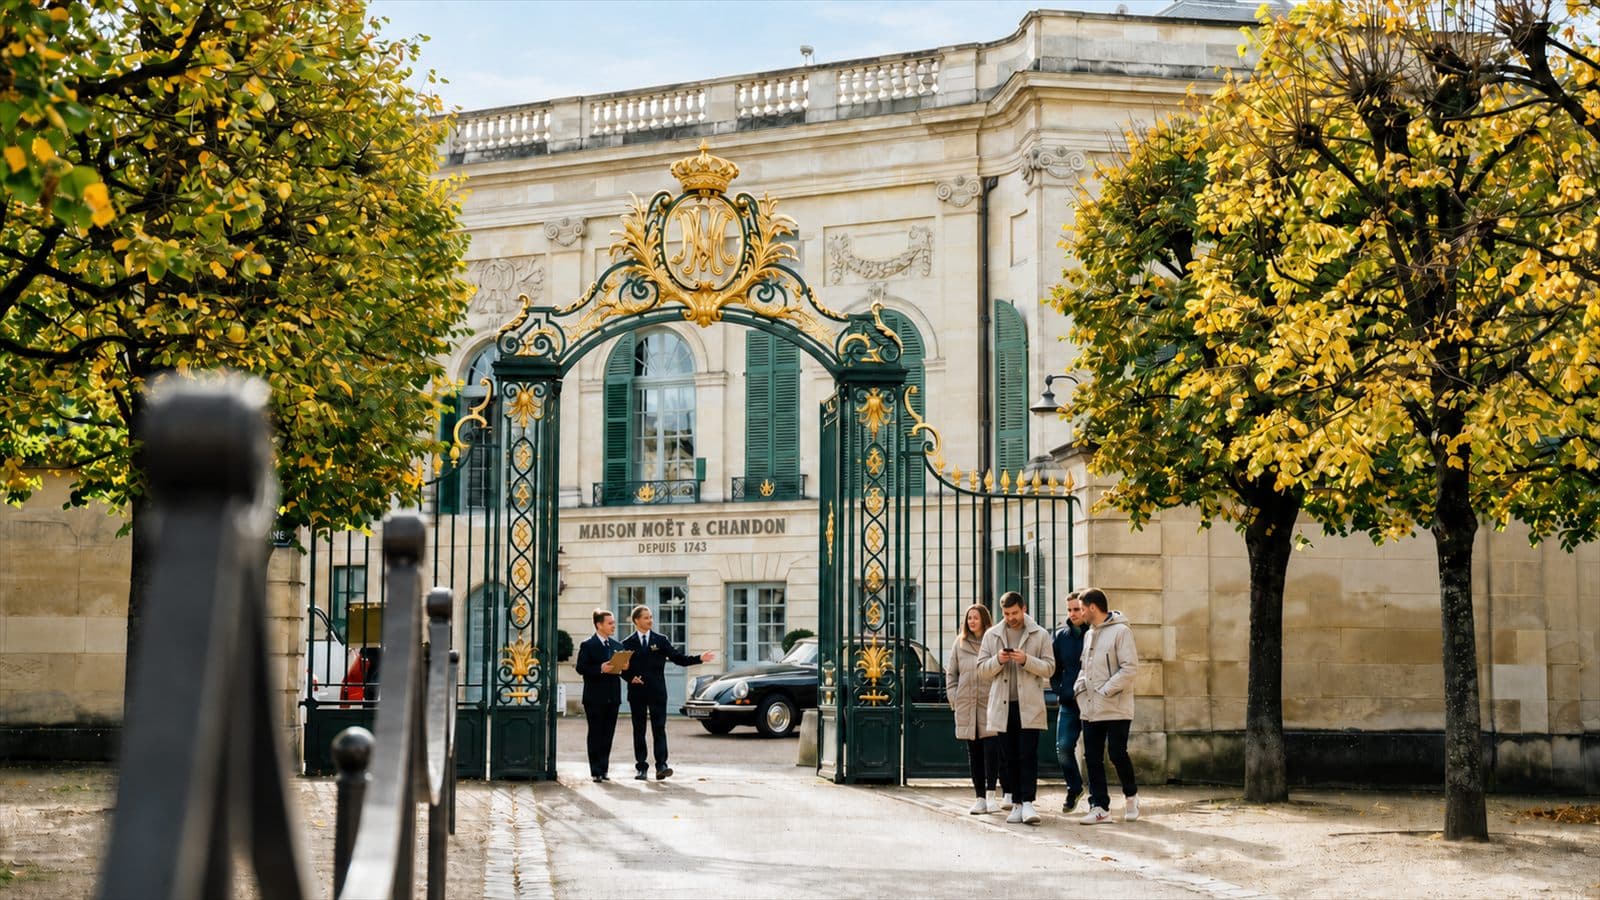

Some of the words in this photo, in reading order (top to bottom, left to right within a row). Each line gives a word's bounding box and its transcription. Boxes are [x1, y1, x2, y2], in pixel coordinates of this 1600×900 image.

[579, 522, 636, 539] MAISON
[642, 518, 685, 537] MOËT
[691, 521, 700, 536] &
[706, 518, 785, 536] CHANDON
[638, 542, 676, 553] DEPUIS
[684, 541, 707, 553] 1743
